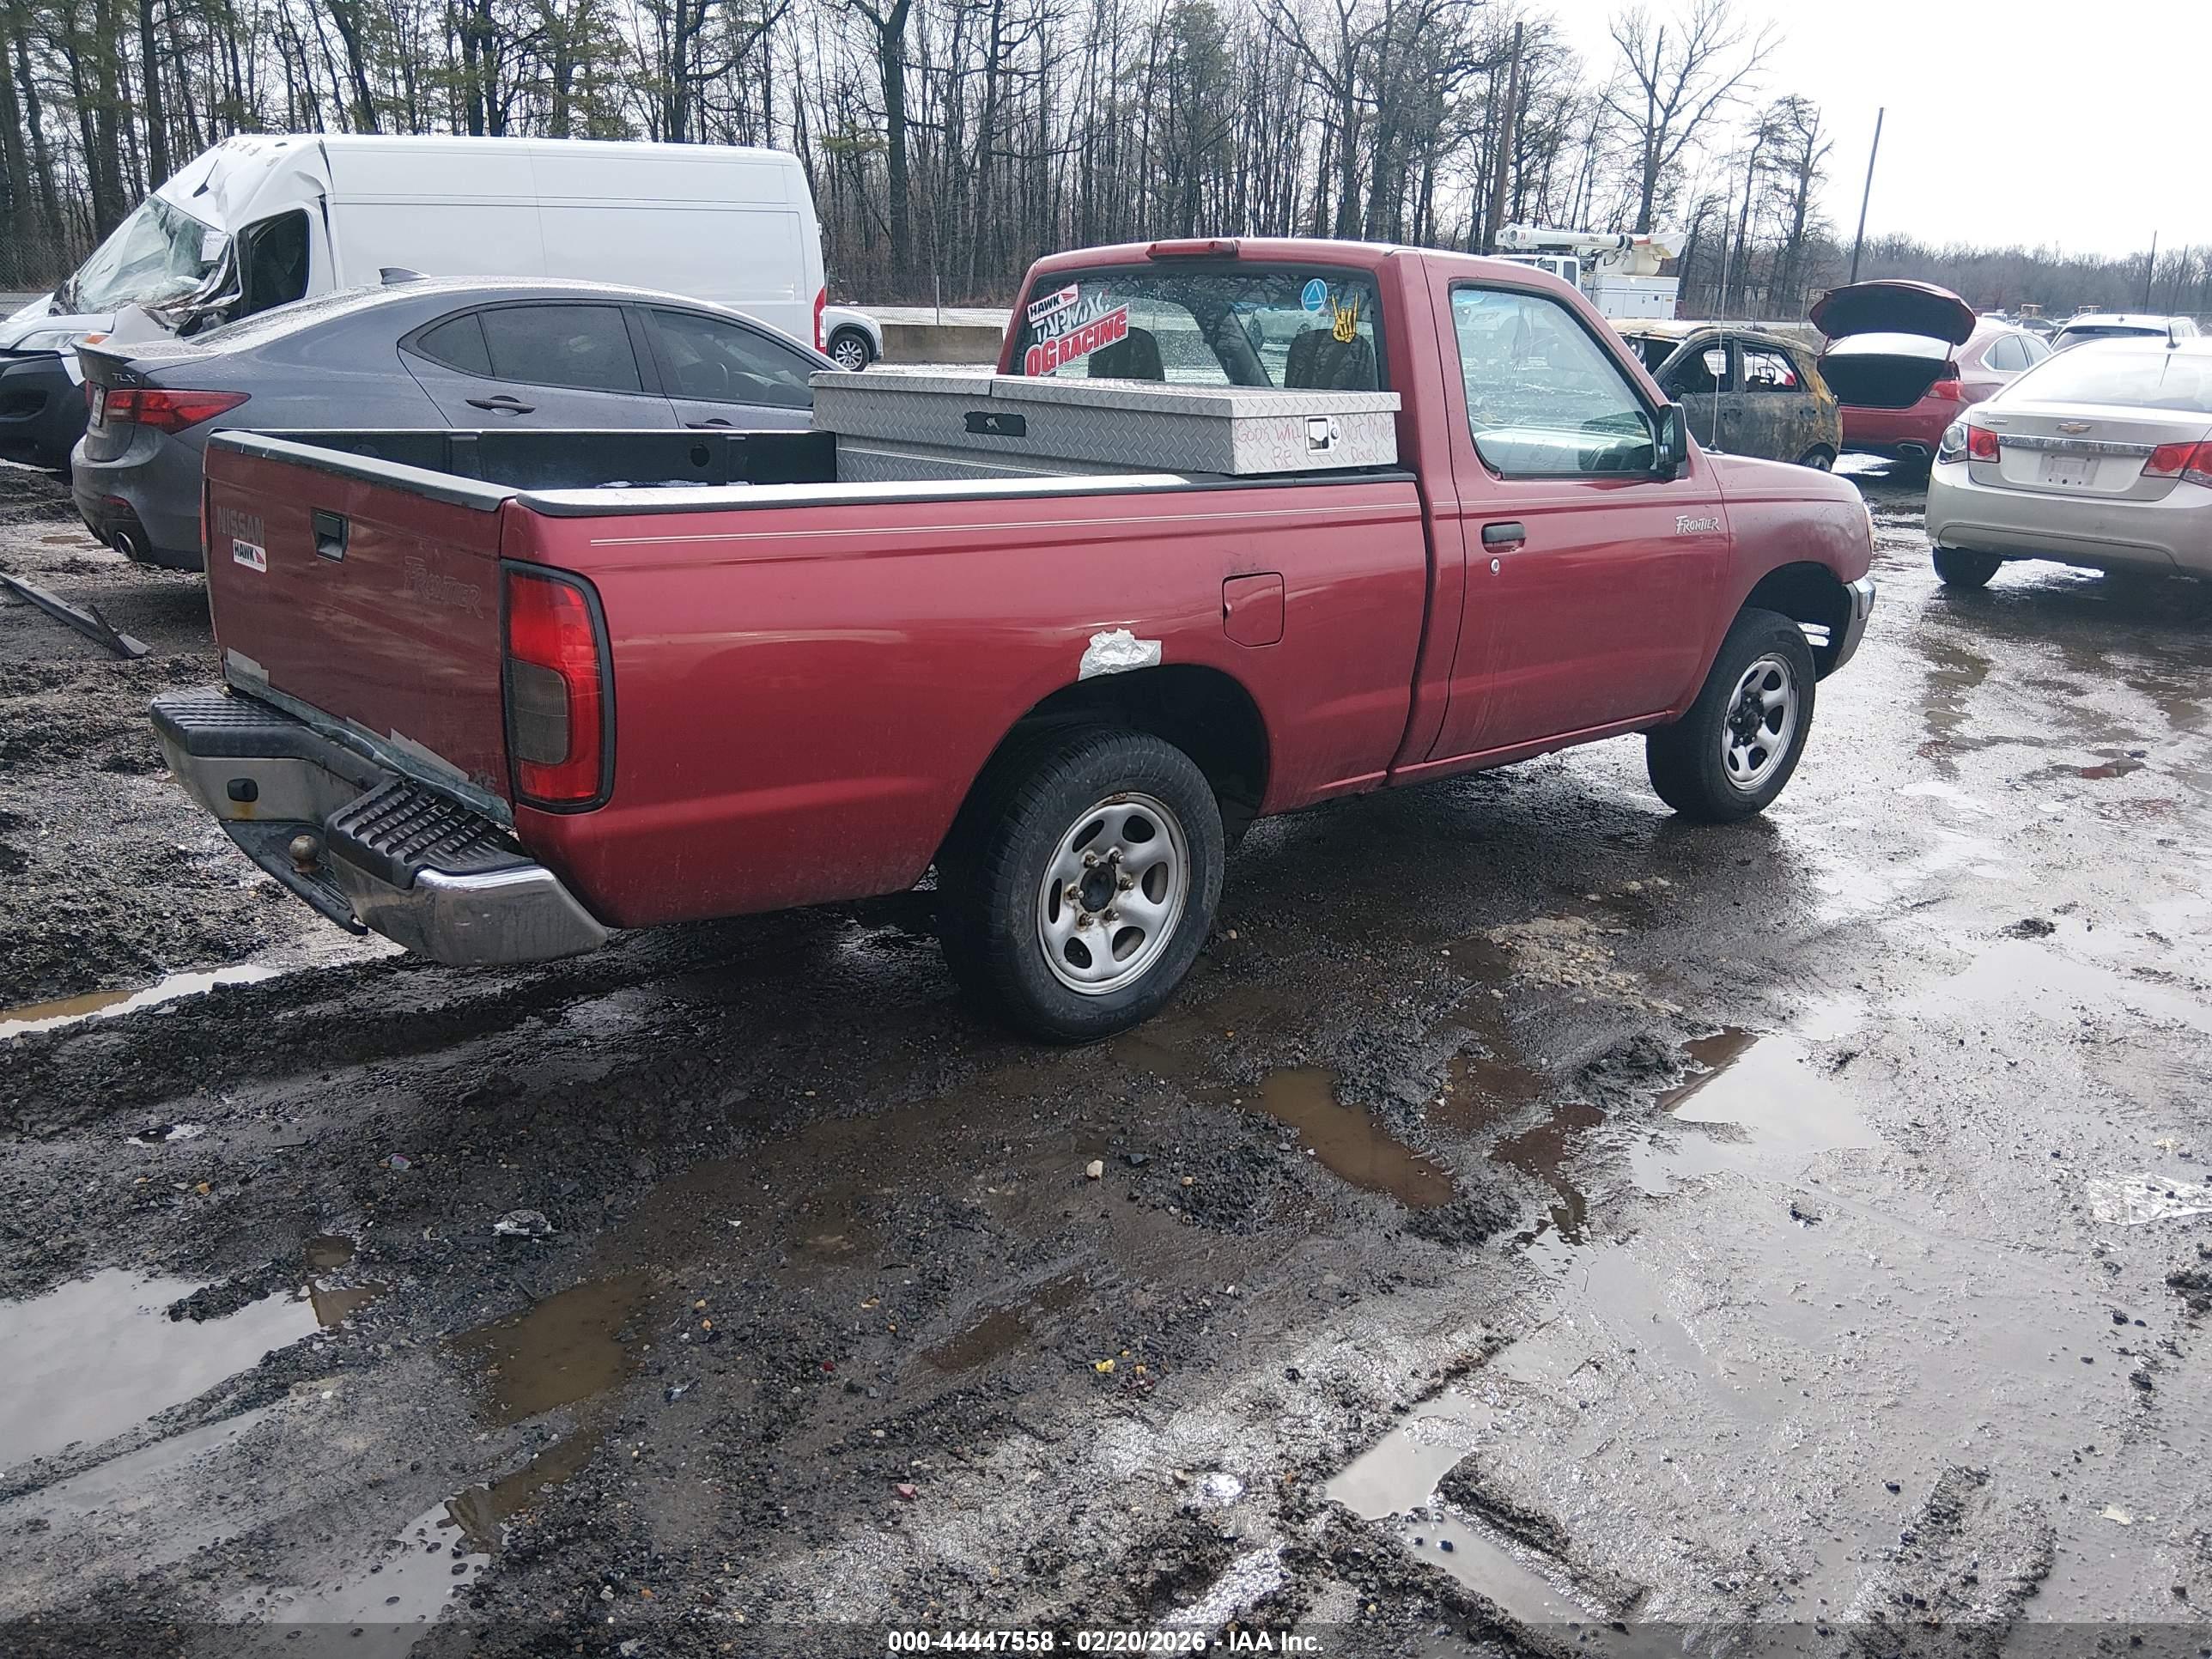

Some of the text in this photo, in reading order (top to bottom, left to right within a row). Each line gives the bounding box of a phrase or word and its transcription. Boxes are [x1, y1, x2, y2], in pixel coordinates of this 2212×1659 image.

[1029, 295, 1060, 318] HAWK
[1026, 313, 1127, 376] OG RACING
[112, 373, 137, 384] TLX
[216, 506, 265, 548] NISSAN
[1675, 515, 1721, 534] FRONTIER
[234, 541, 255, 562] HAWK
